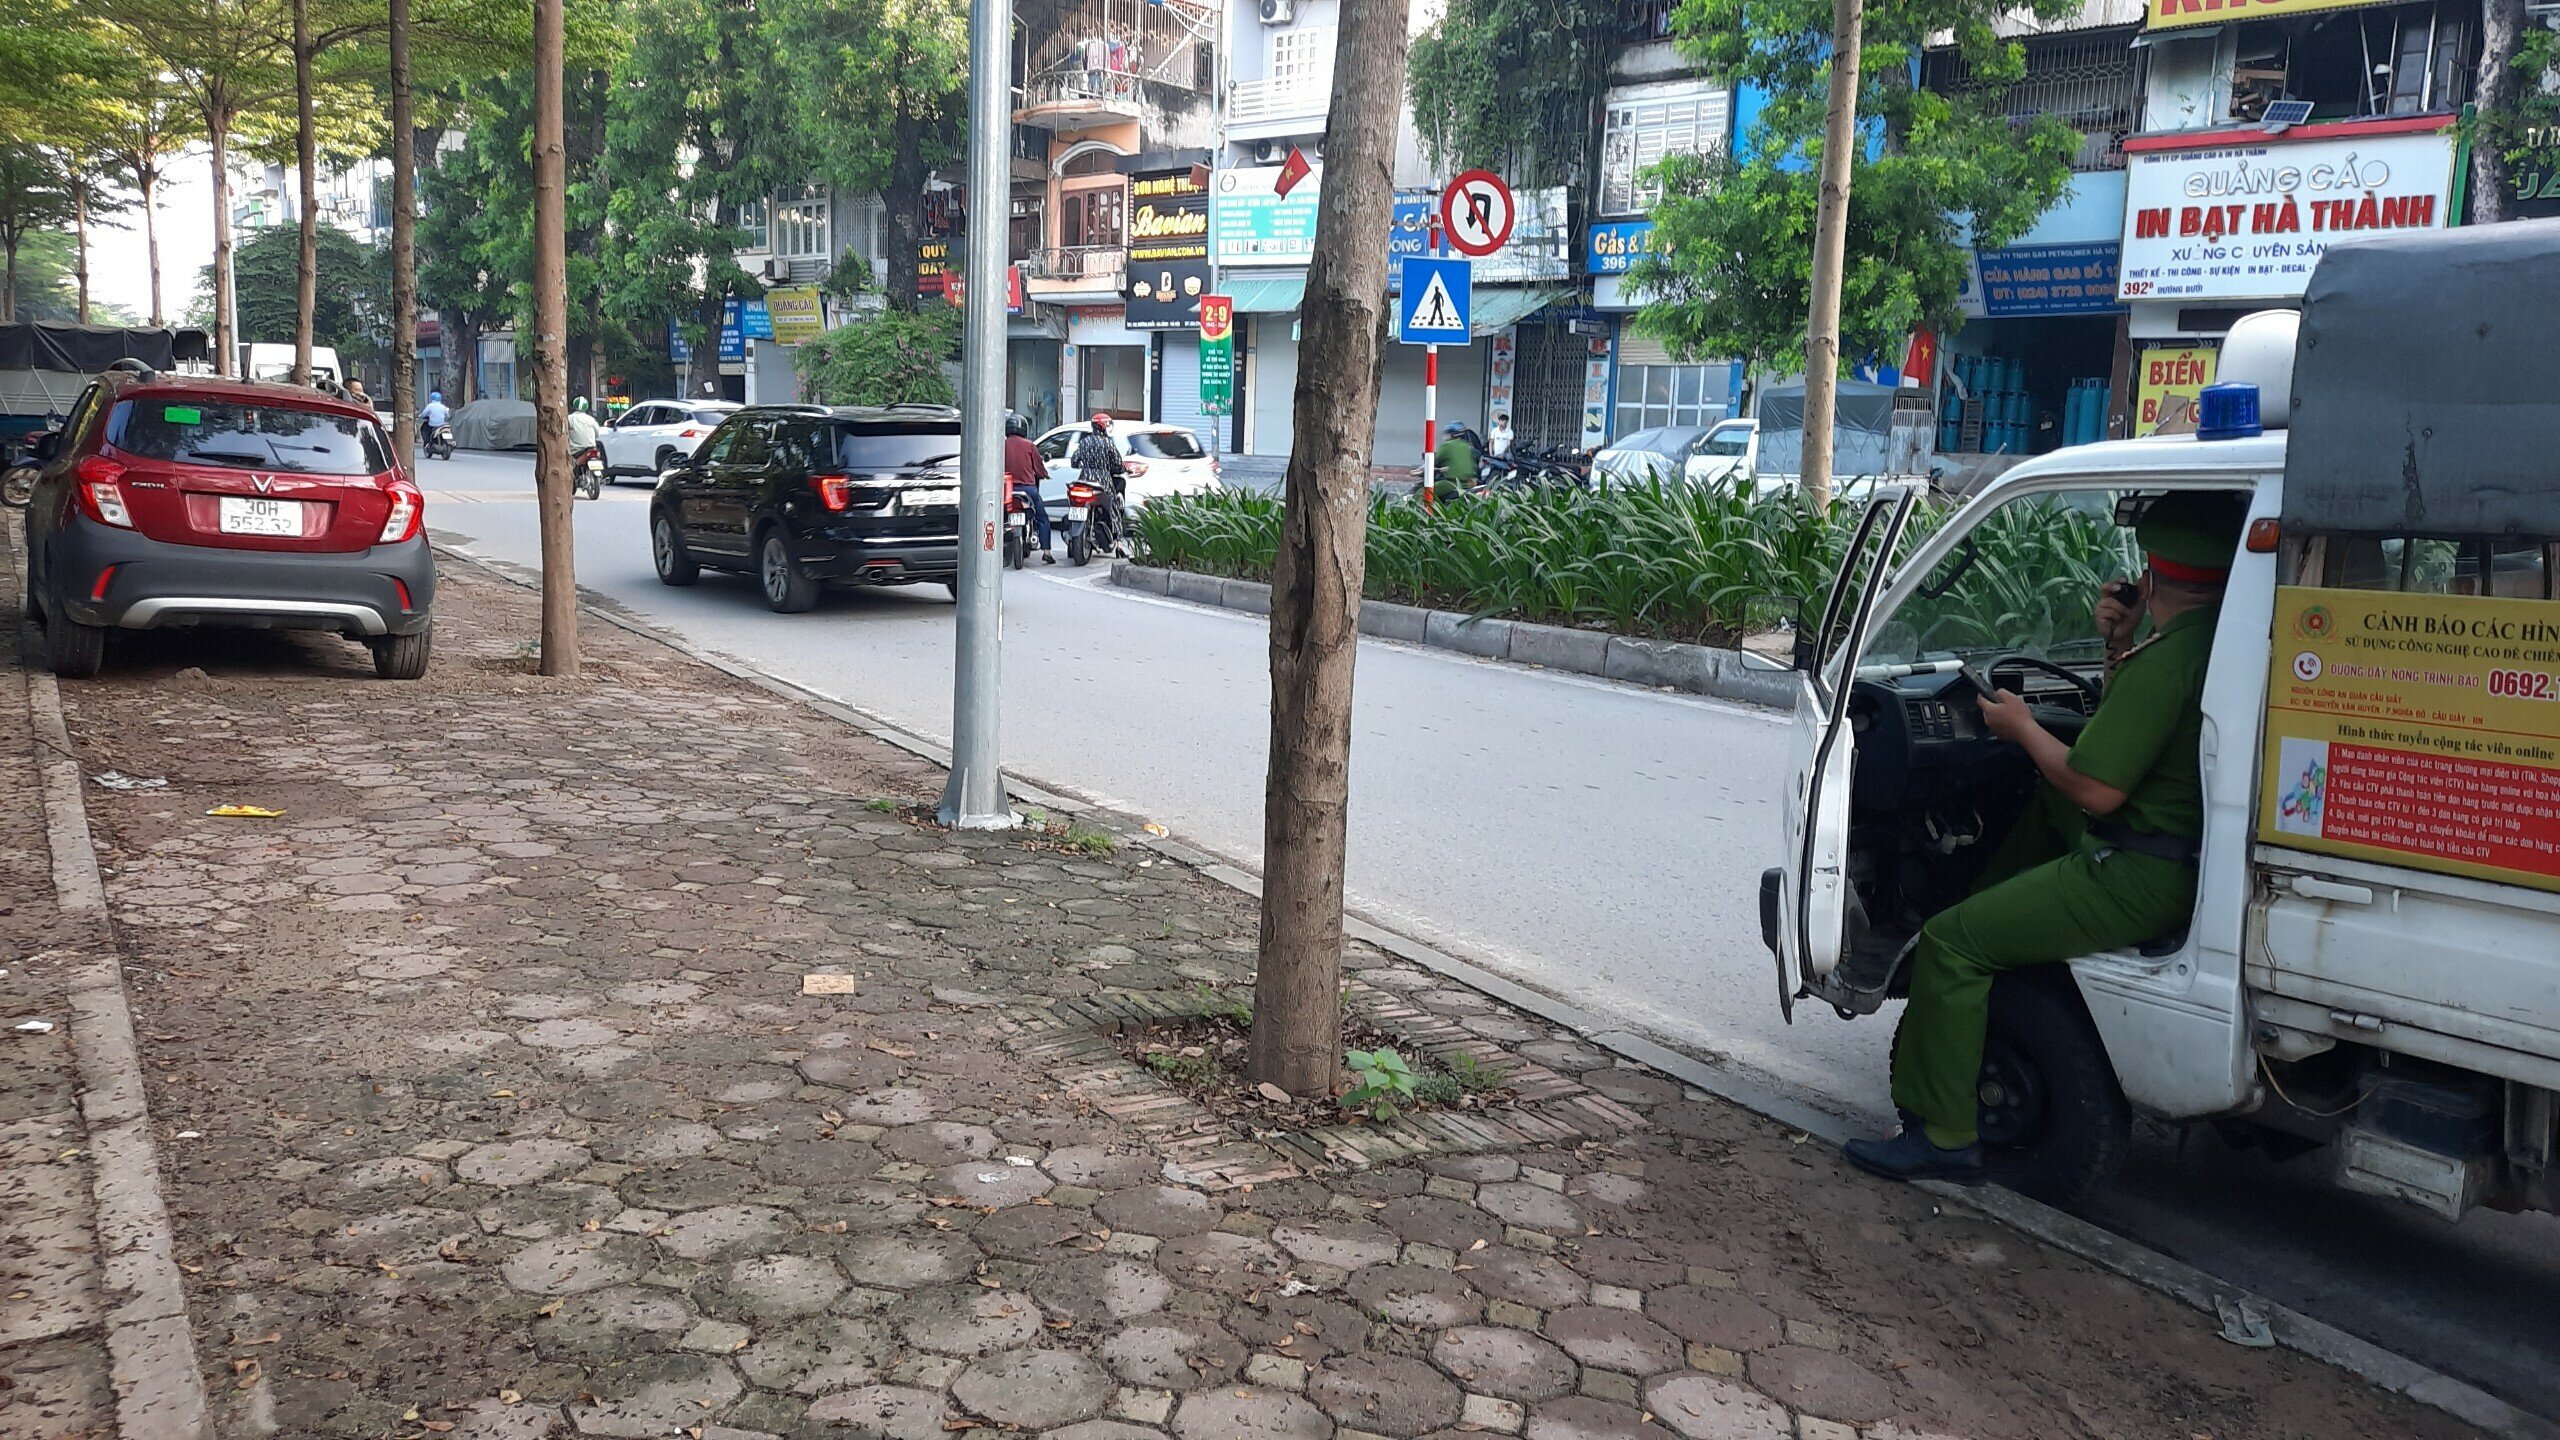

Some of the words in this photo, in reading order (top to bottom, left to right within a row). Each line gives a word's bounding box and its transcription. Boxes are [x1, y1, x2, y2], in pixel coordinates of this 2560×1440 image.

[2183, 159, 2301, 197] QUẢNG
[2306, 151, 2390, 191] CÁO
[1130, 204, 1207, 237] Bavian
[2135, 207, 2172, 239] IN
[2179, 204, 2247, 243] BẠT
[2251, 194, 2301, 235] HÀ
[2309, 189, 2436, 232] THÀNH
[1601, 256, 1627, 270] 396
[1205, 304, 1227, 322] 2-9
[2148, 351, 2207, 386] BIỂN
[2363, 610, 2418, 633] CẢNH
[2424, 613, 2466, 637] BÁO
[2471, 616, 2516, 641] CÁC
[2363, 637, 2396, 651] DỤNG
[2398, 638, 2433, 653] CÔNG
[2435, 642, 2471, 659] NGHỆ
[2473, 646, 2500, 659] CAO
[2338, 724, 2366, 738] Hình
[2398, 729, 2430, 747] tuyển
[2433, 733, 2461, 752] cộng
[2464, 738, 2483, 752] tác
[2486, 740, 2512, 755] viên
[2515, 745, 2555, 760] online
[2476, 846, 2491, 858] CTV
